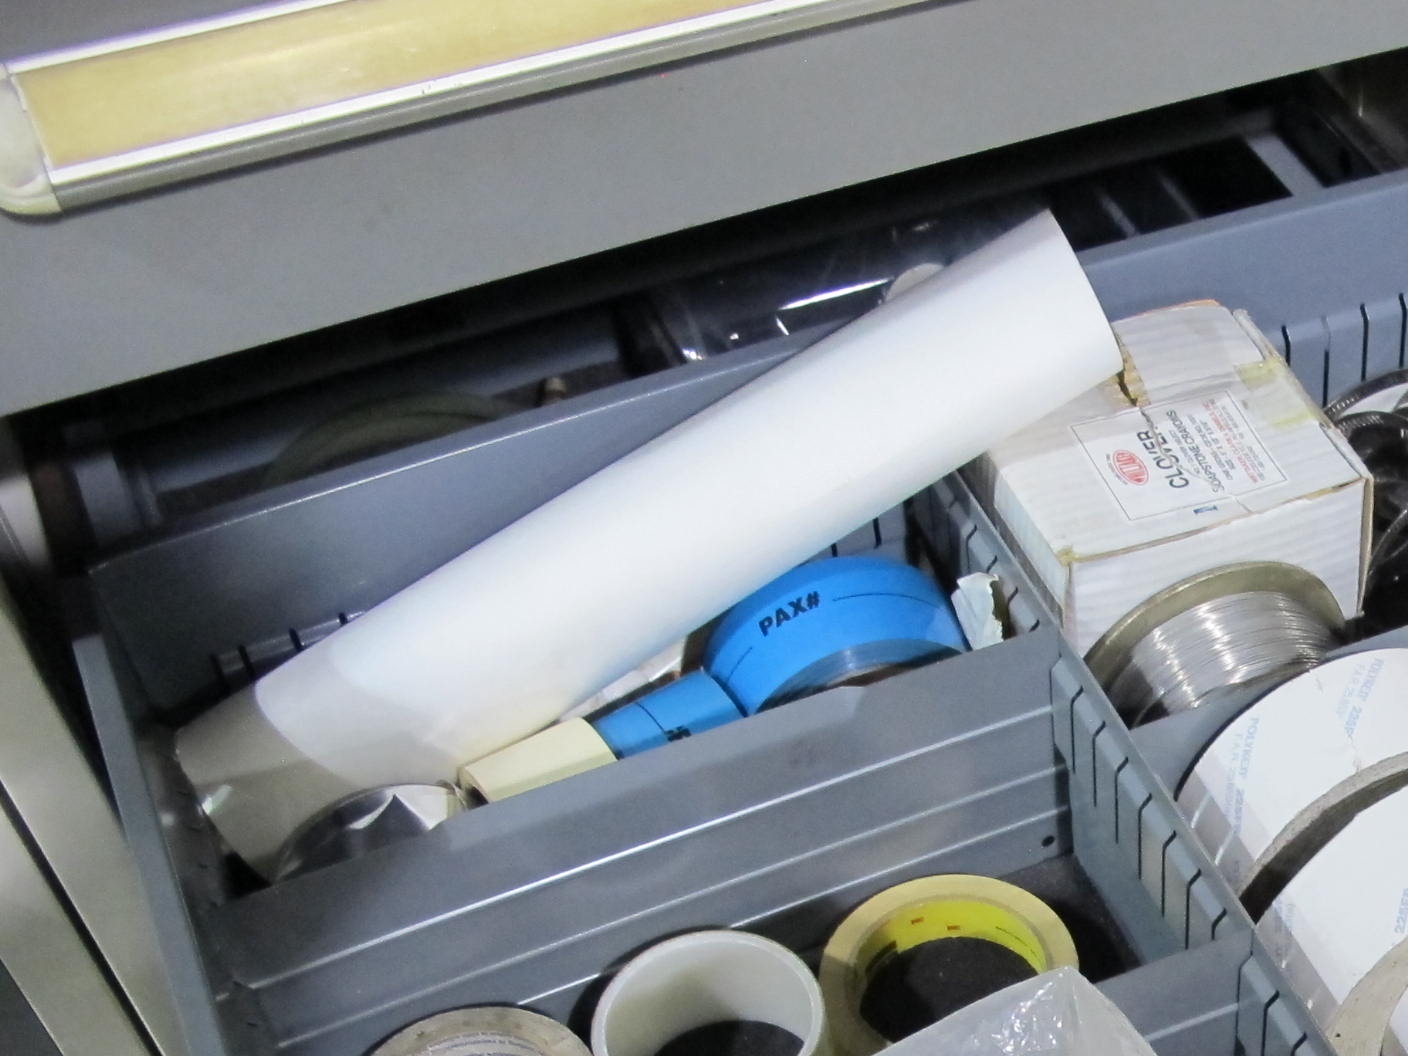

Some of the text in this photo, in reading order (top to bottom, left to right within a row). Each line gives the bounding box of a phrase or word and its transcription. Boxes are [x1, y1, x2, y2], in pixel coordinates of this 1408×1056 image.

[1134, 426, 1194, 490] CLOVER
[1184, 443, 1226, 493] SOAPSTONE
[758, 591, 820, 637] PAX#
